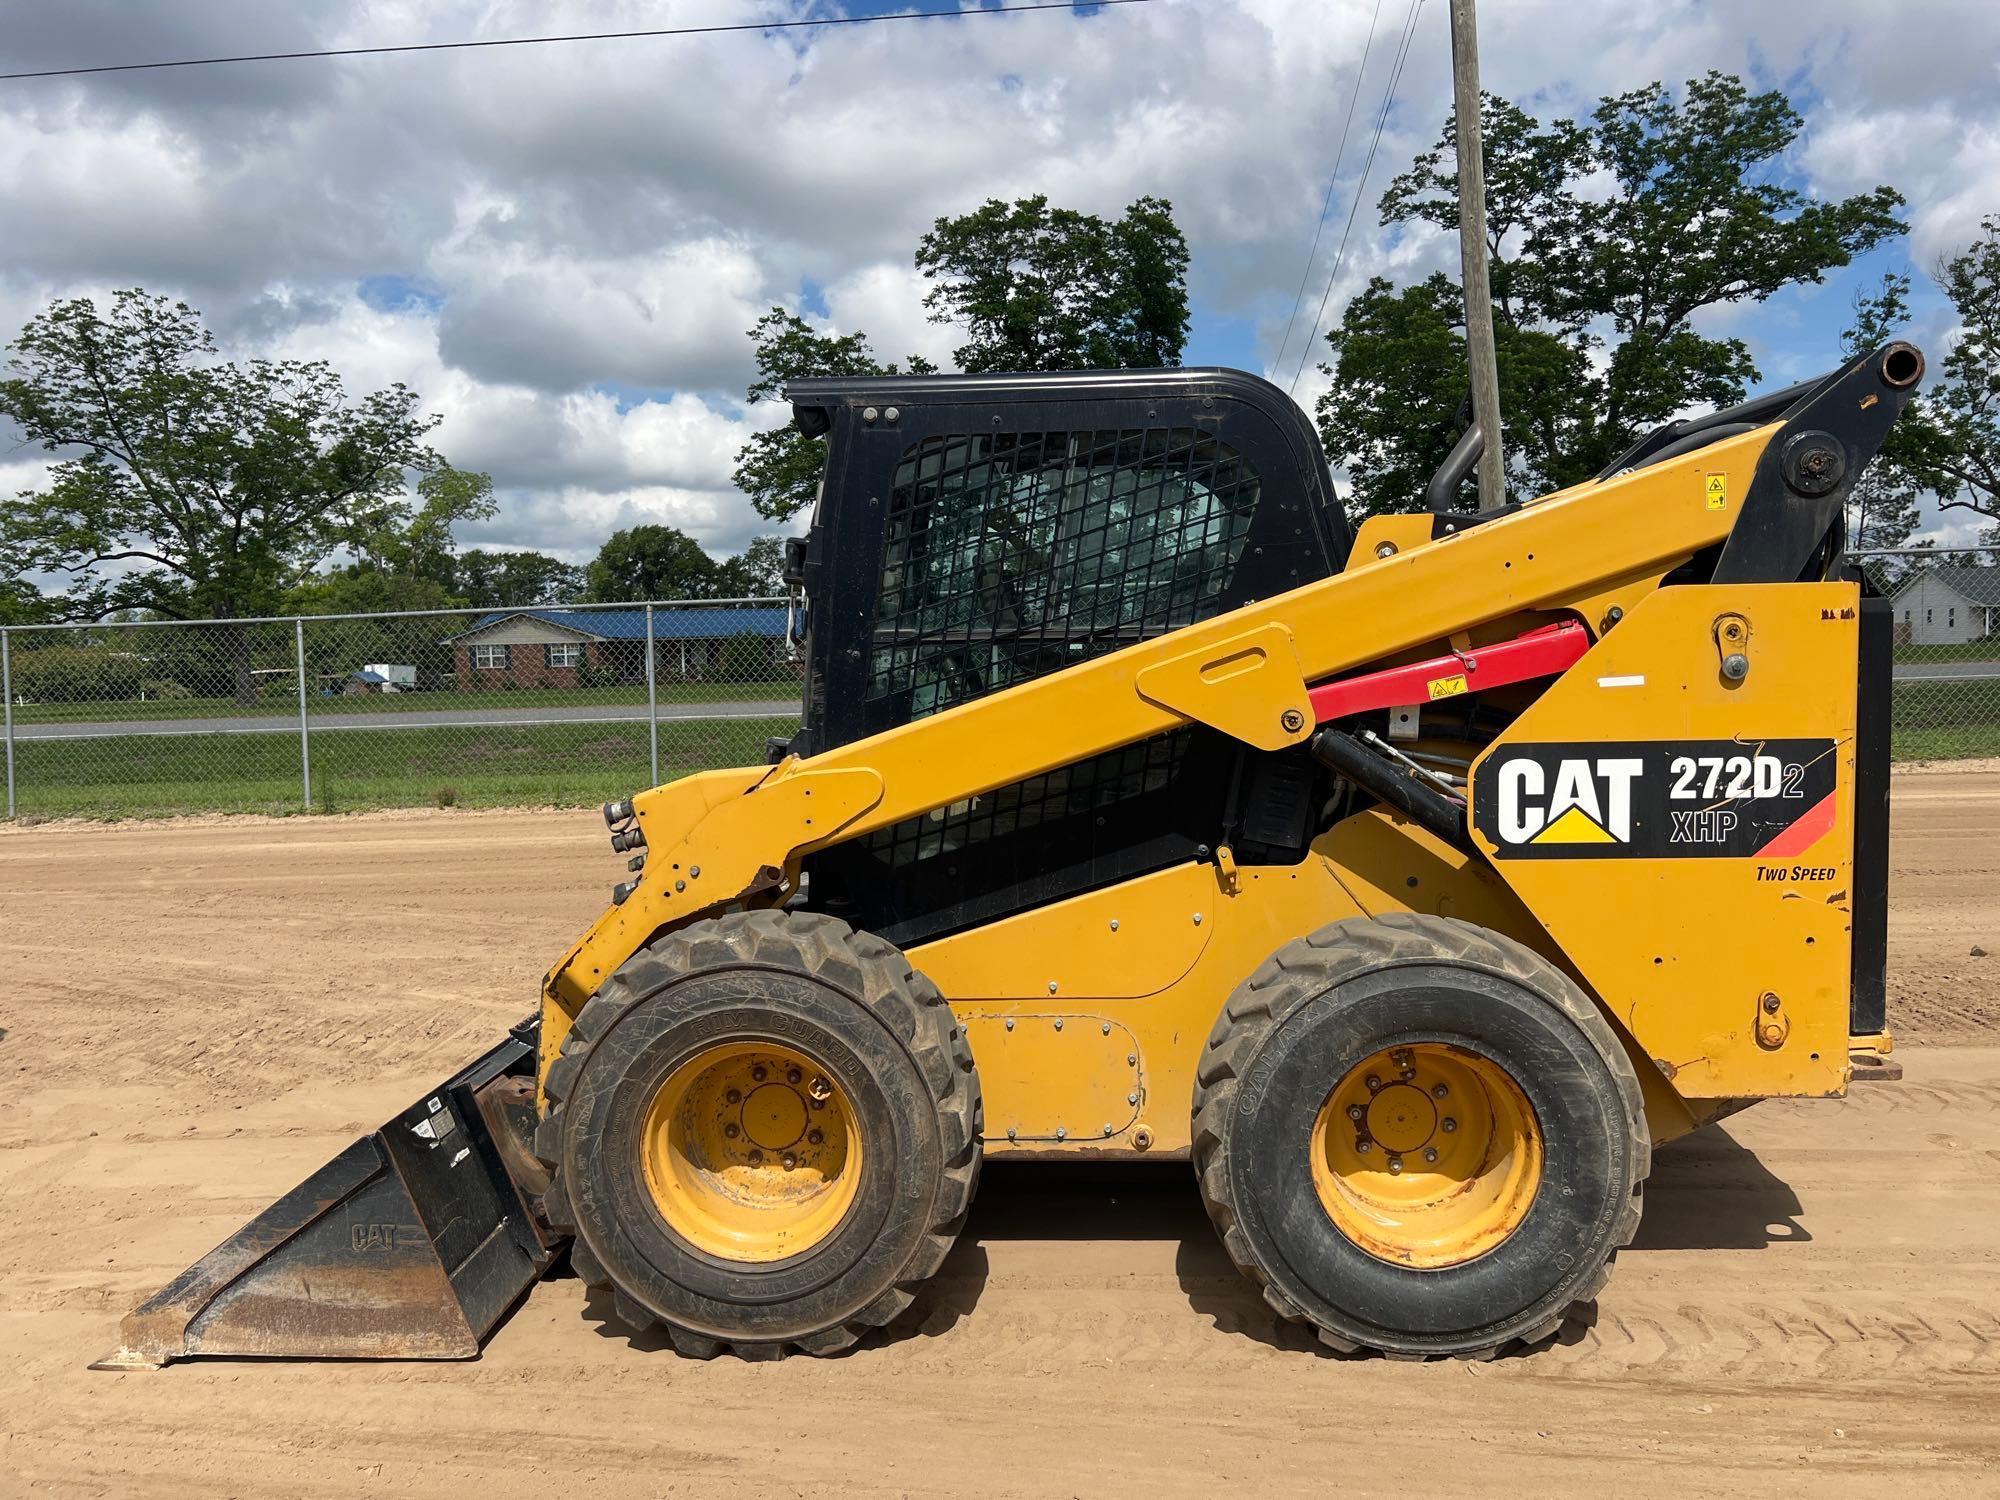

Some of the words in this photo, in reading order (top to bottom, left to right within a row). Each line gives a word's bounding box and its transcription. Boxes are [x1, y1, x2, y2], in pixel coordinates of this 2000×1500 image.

[1498, 758, 1643, 843] CAT
[1669, 810, 1738, 842] XHP
[691, 1012, 750, 1040] RIM
[769, 1014, 861, 1076] GUARD
[1240, 988, 1338, 1115] GALAXY
[352, 1224, 396, 1251] CAT
